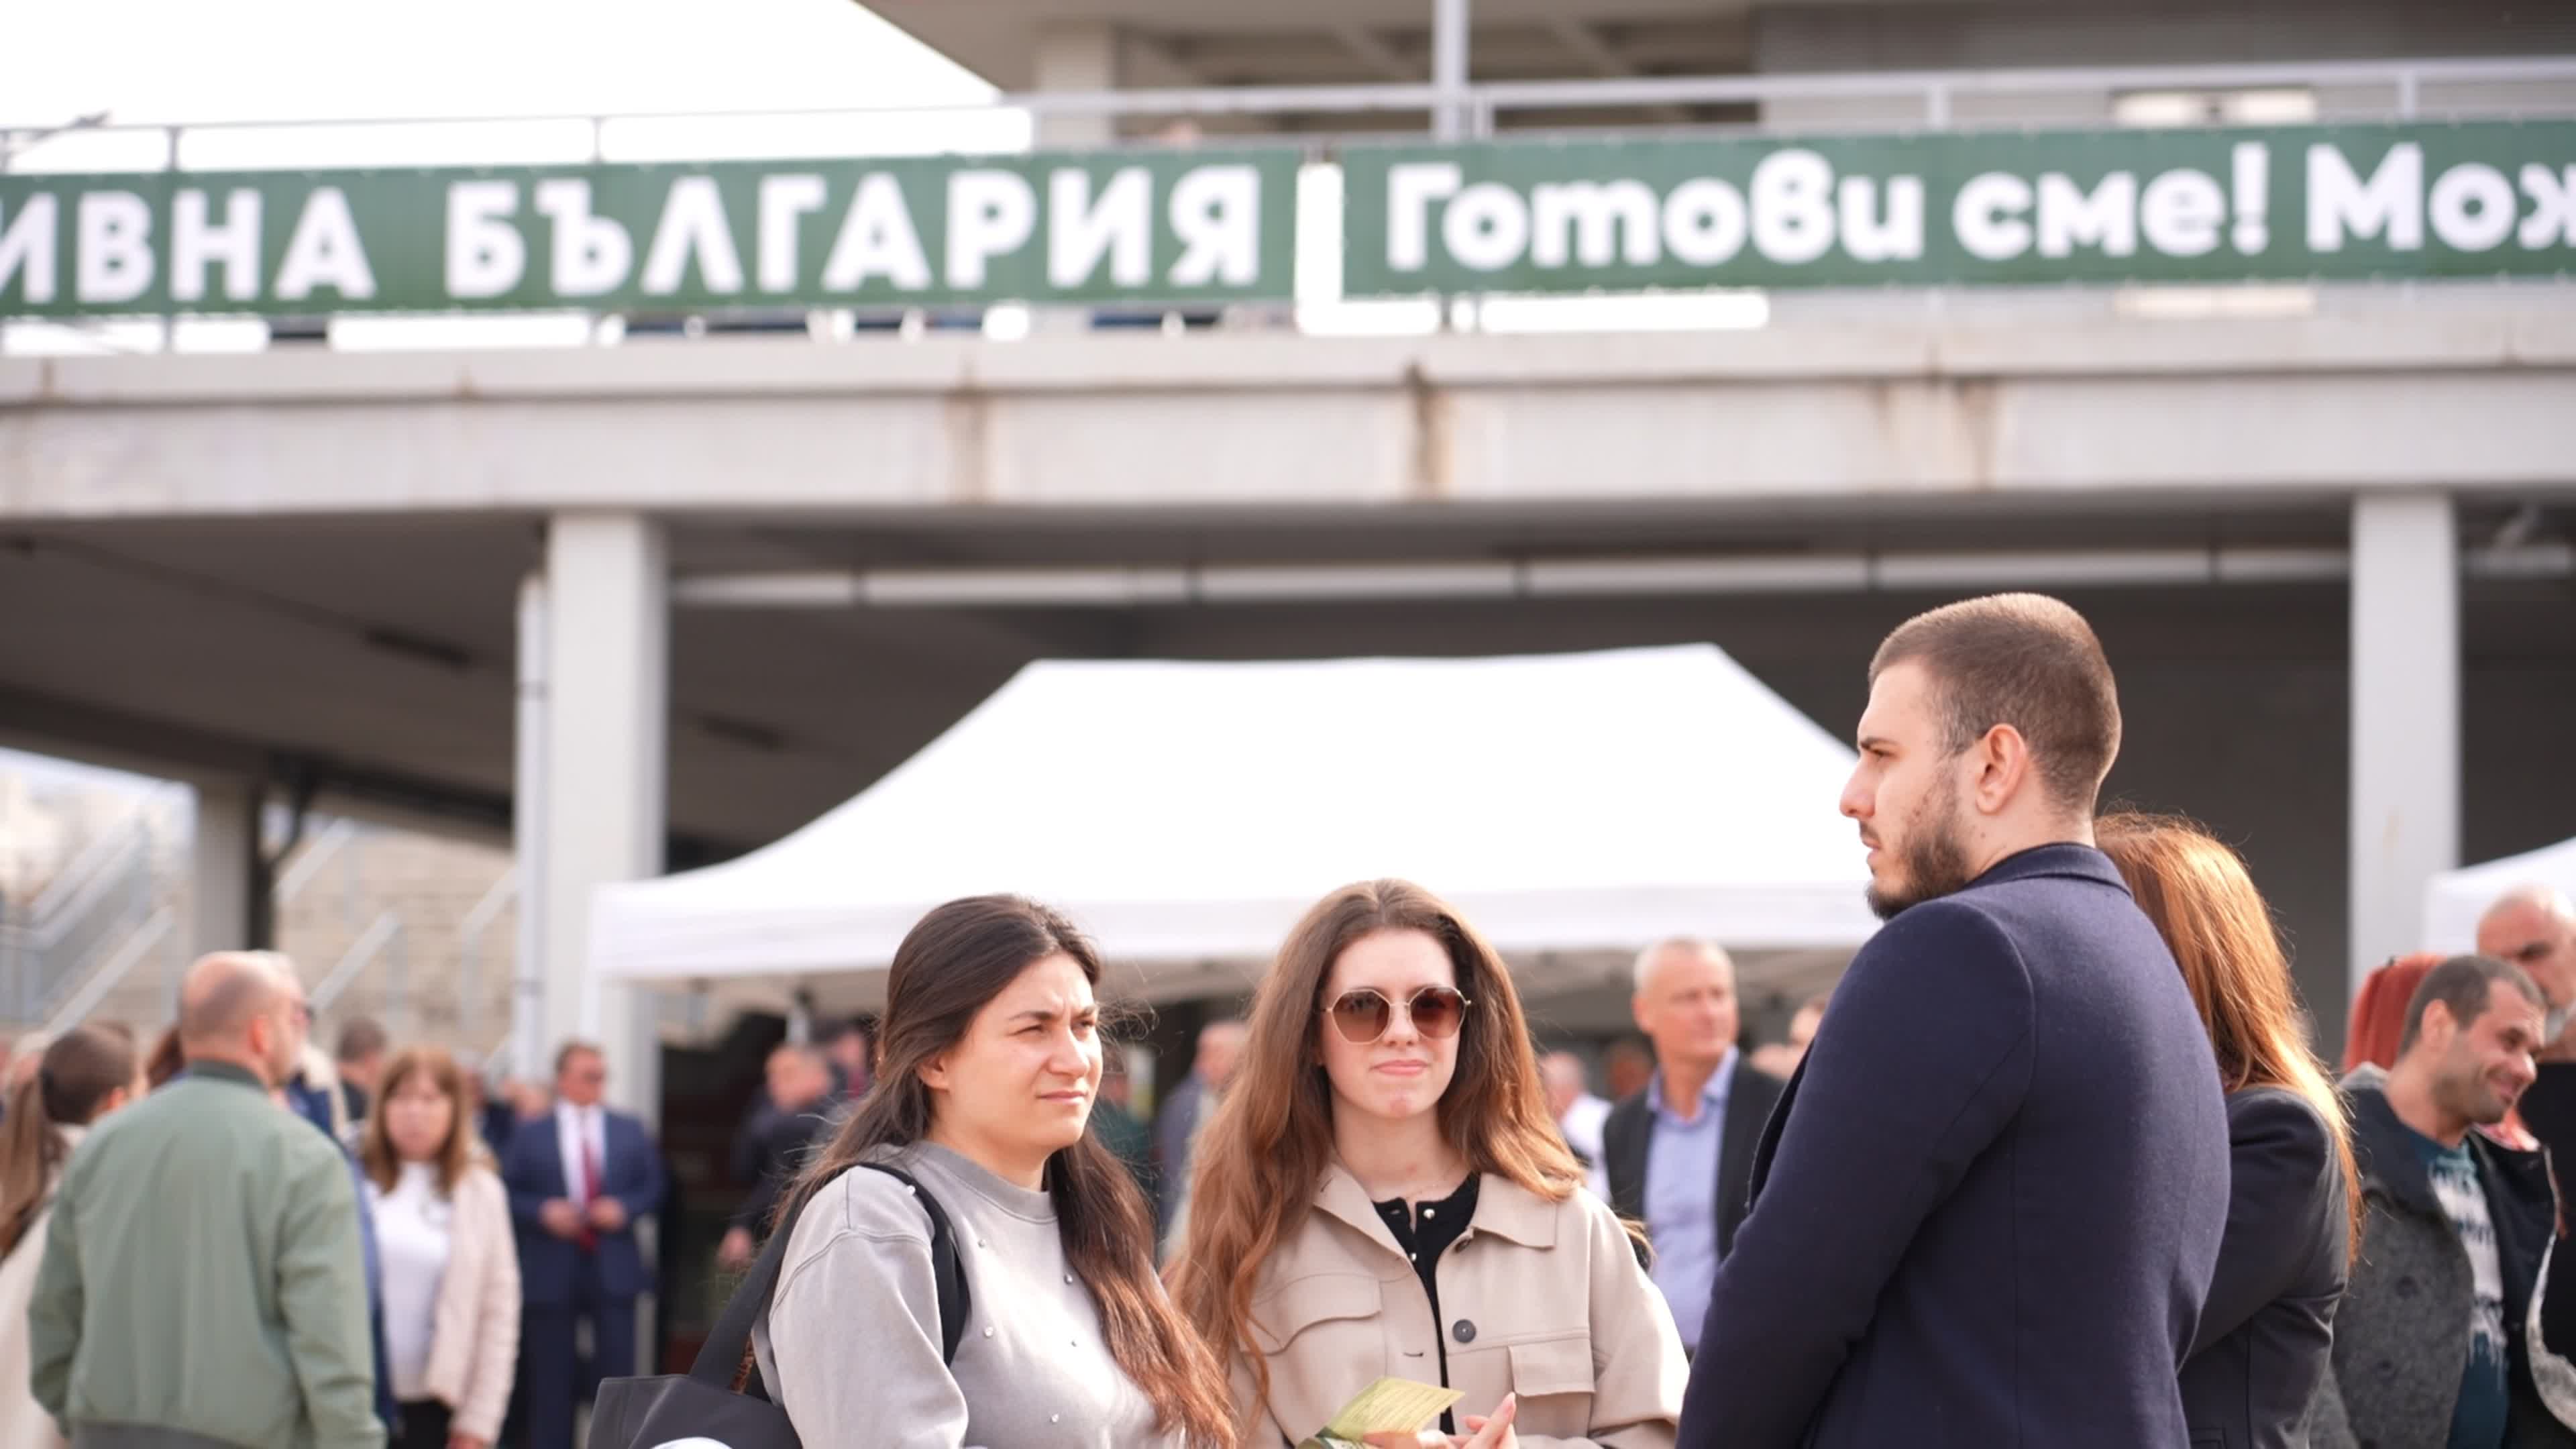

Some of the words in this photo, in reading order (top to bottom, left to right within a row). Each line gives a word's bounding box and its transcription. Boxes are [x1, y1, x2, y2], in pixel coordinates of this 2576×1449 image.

[444, 167, 1261, 299] БЪЛГАРИЯ
[1386, 148, 1925, 270] Готови
[1951, 142, 2270, 260] сме!
